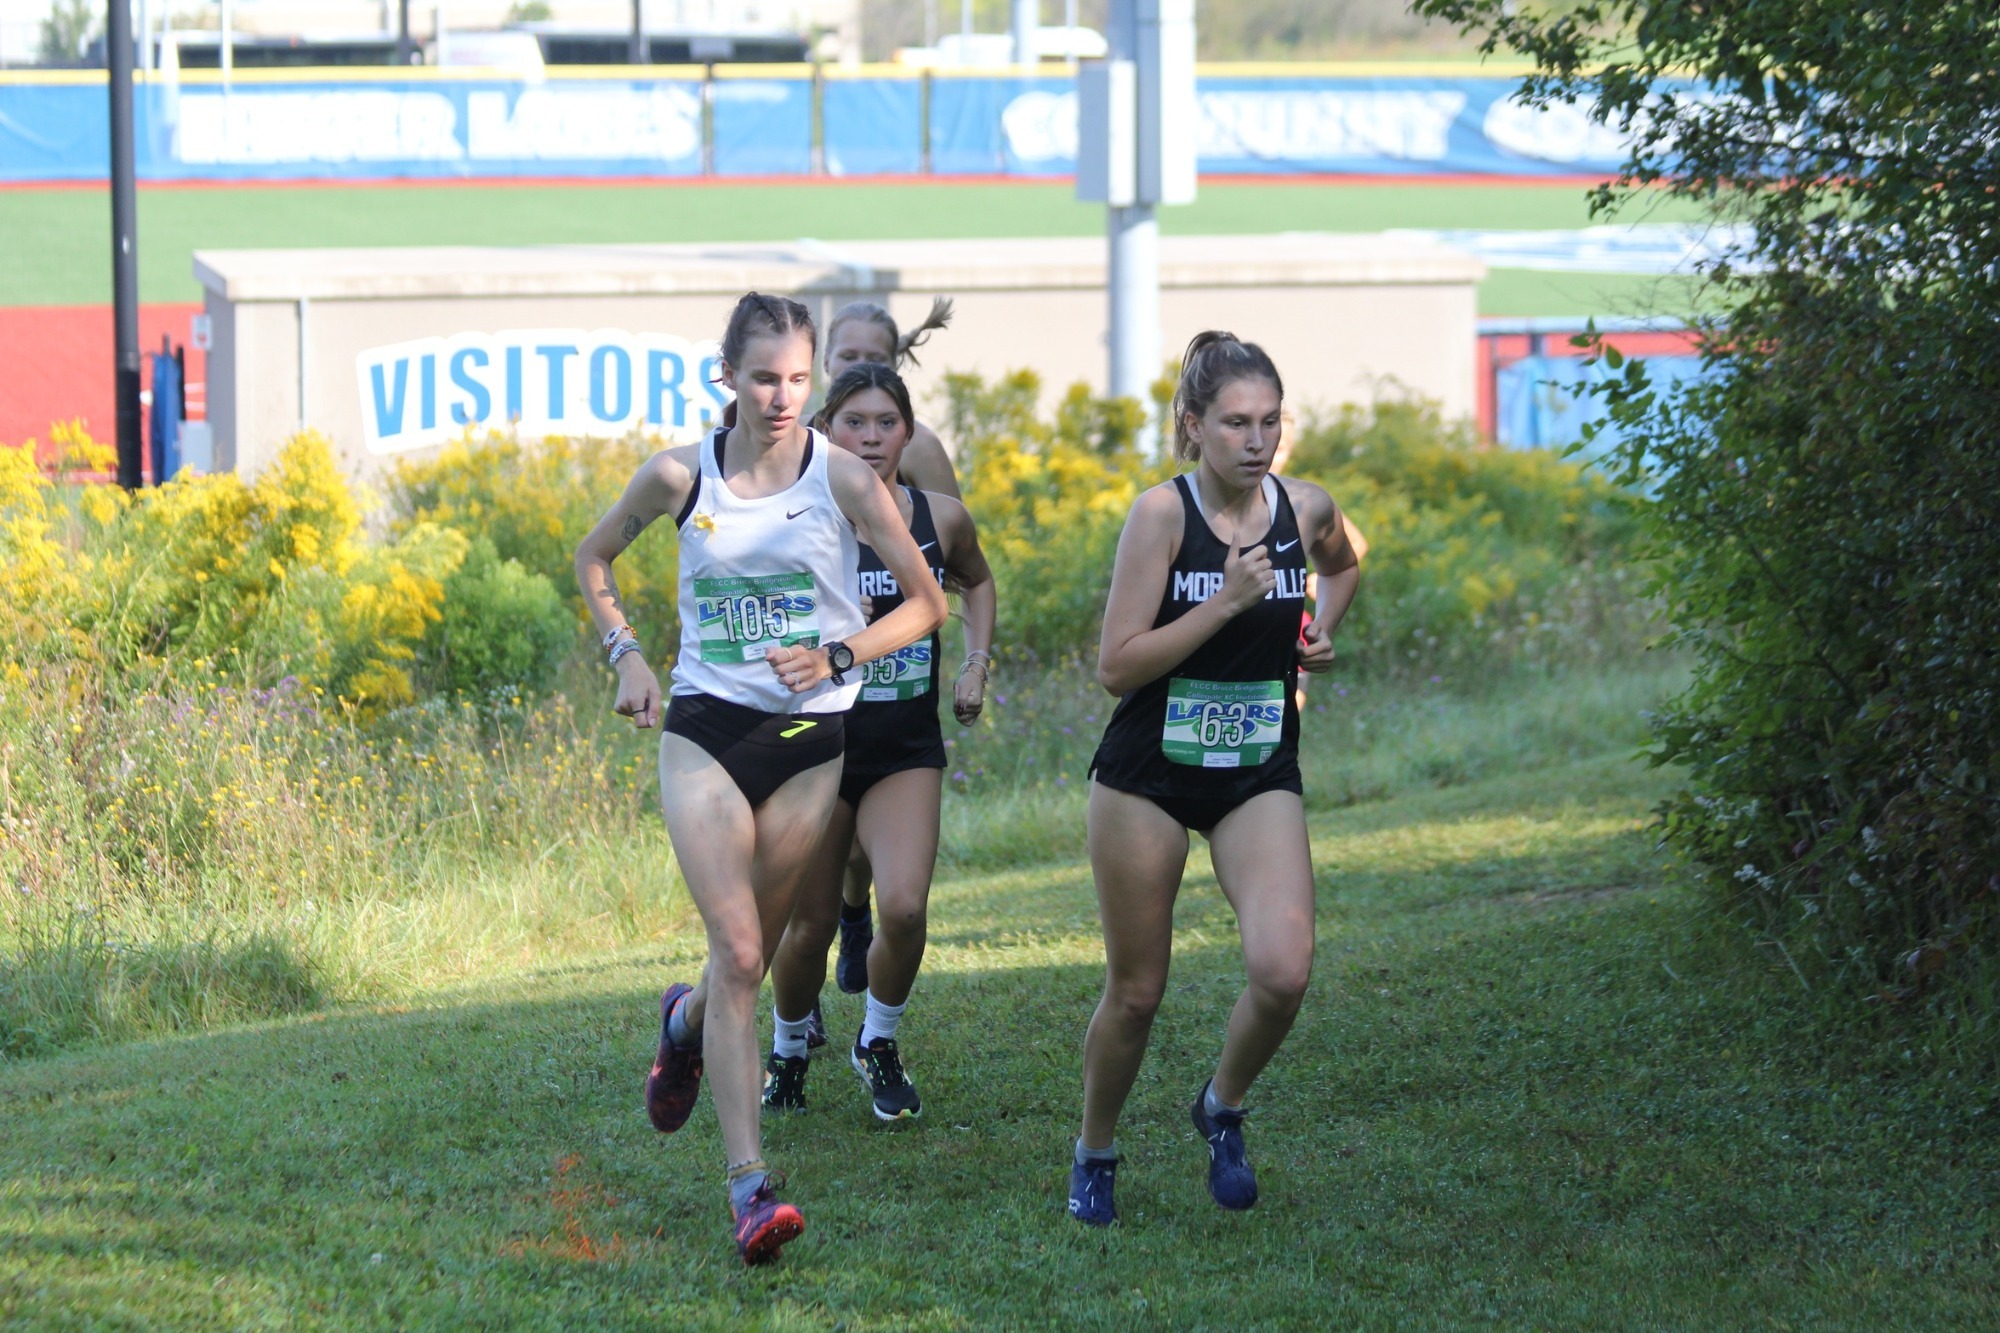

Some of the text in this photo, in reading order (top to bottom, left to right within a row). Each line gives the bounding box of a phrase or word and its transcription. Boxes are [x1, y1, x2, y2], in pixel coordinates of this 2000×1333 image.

[370, 345, 726, 438] VISITORS
[1173, 568, 1306, 602] MORILLE
[718, 593, 789, 643] 105
[1198, 700, 1247, 748] 63
